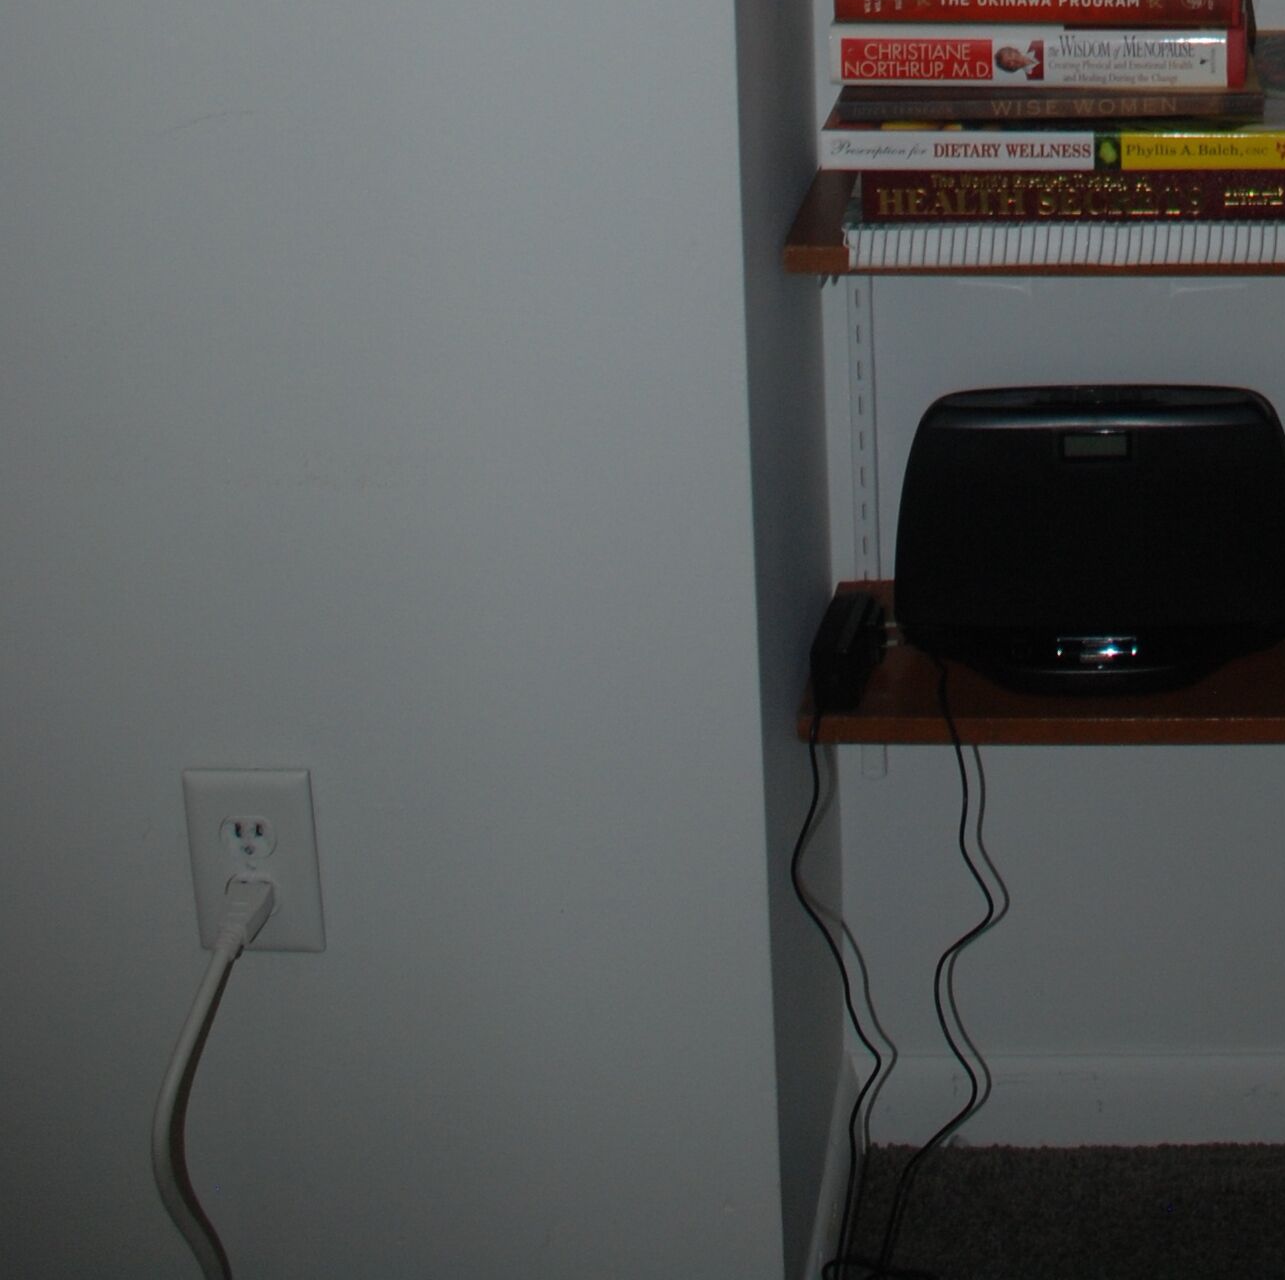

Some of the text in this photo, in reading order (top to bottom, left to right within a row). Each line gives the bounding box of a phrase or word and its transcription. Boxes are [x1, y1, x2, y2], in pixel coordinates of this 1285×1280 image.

[863, 43, 972, 59] CHRISTIANE
[1059, 35, 1110, 58] WISDOM
[1123, 35, 1195, 58] MENOPAUSE
[952, 61, 992, 78] M.D.
[991, 98, 1177, 115] WISE WOMEN
[831, 142, 1092, 160] Prescription for DIETARY WELLNESS
